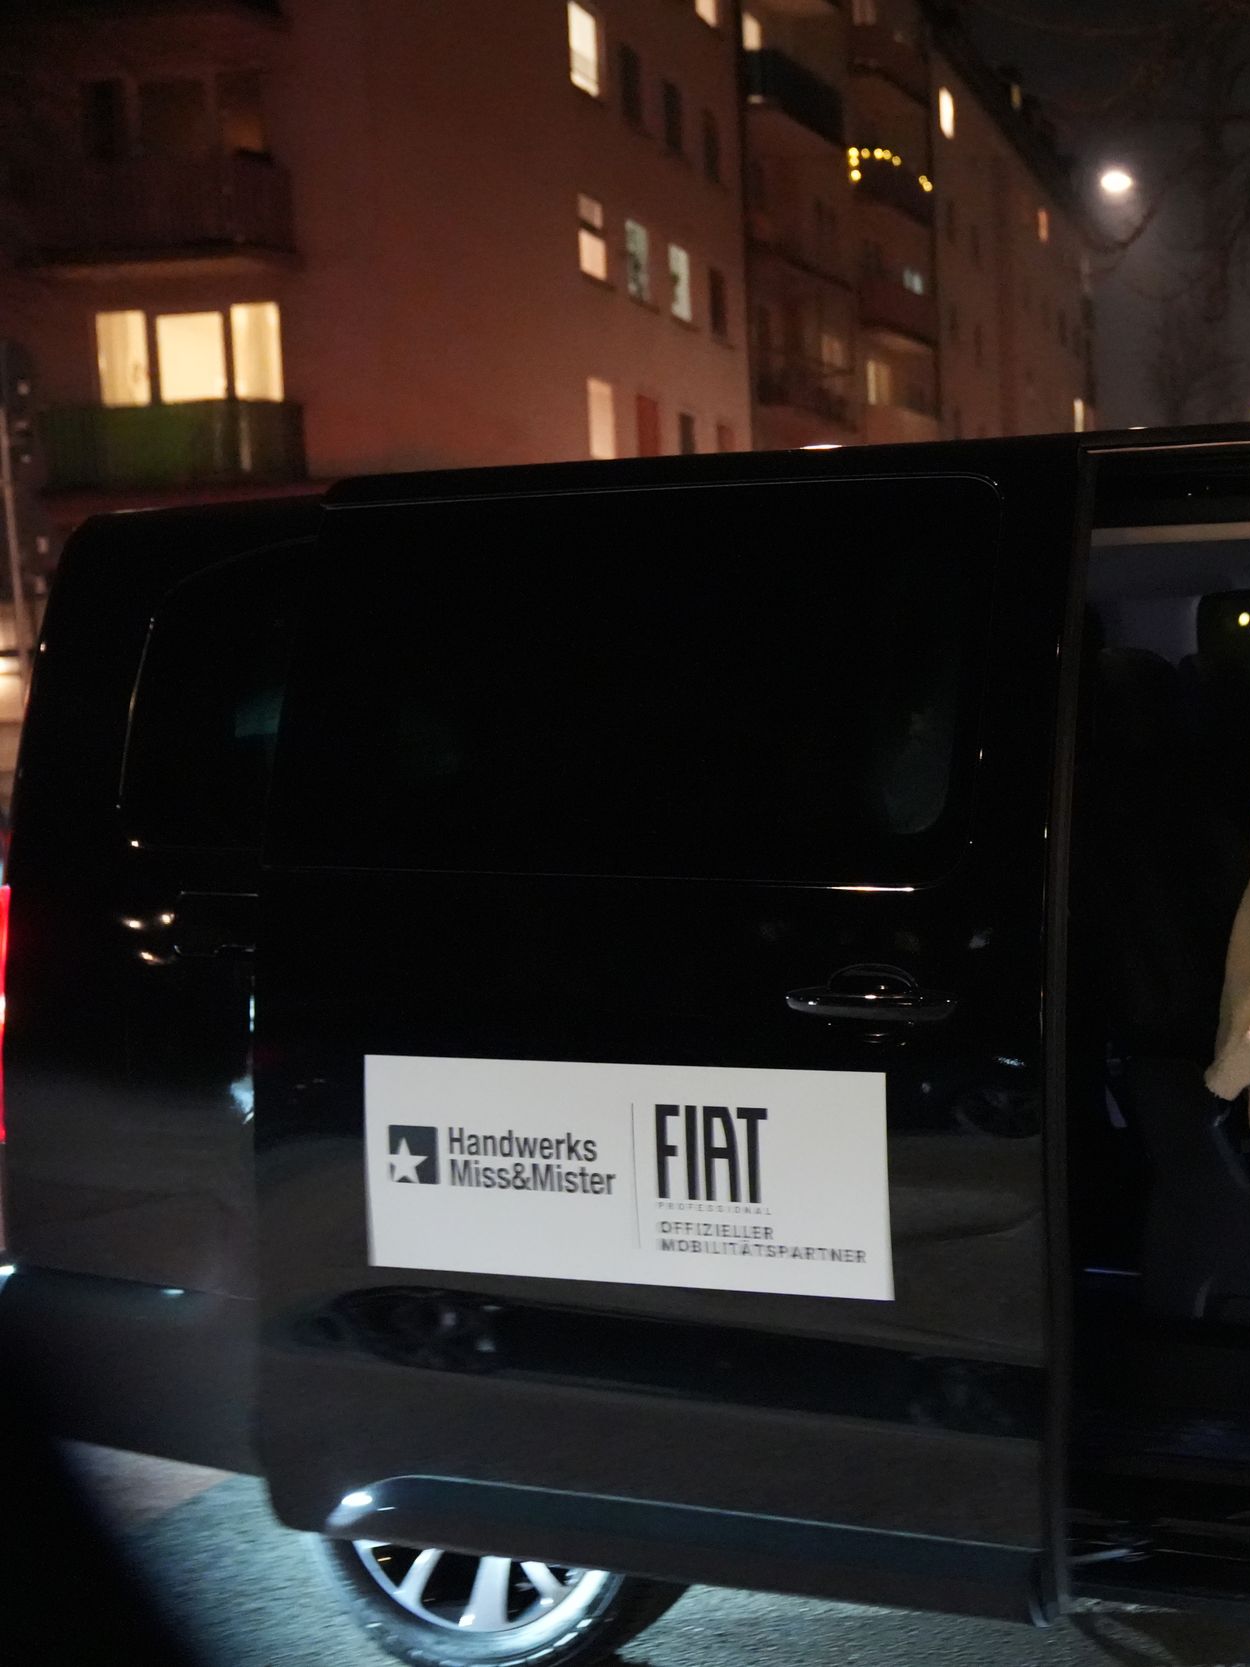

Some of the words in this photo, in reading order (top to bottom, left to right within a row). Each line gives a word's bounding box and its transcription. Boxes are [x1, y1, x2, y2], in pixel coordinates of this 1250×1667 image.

[448, 1126, 598, 1162] Handwerks
[655, 1103, 768, 1204] FIAT
[450, 1158, 616, 1195] Miss&Mister
[658, 1202, 772, 1216] PROFESSIONAL
[660, 1221, 774, 1240] OFFIZIELLER
[660, 1238, 867, 1264] MOBILITÄTSPARTNER
